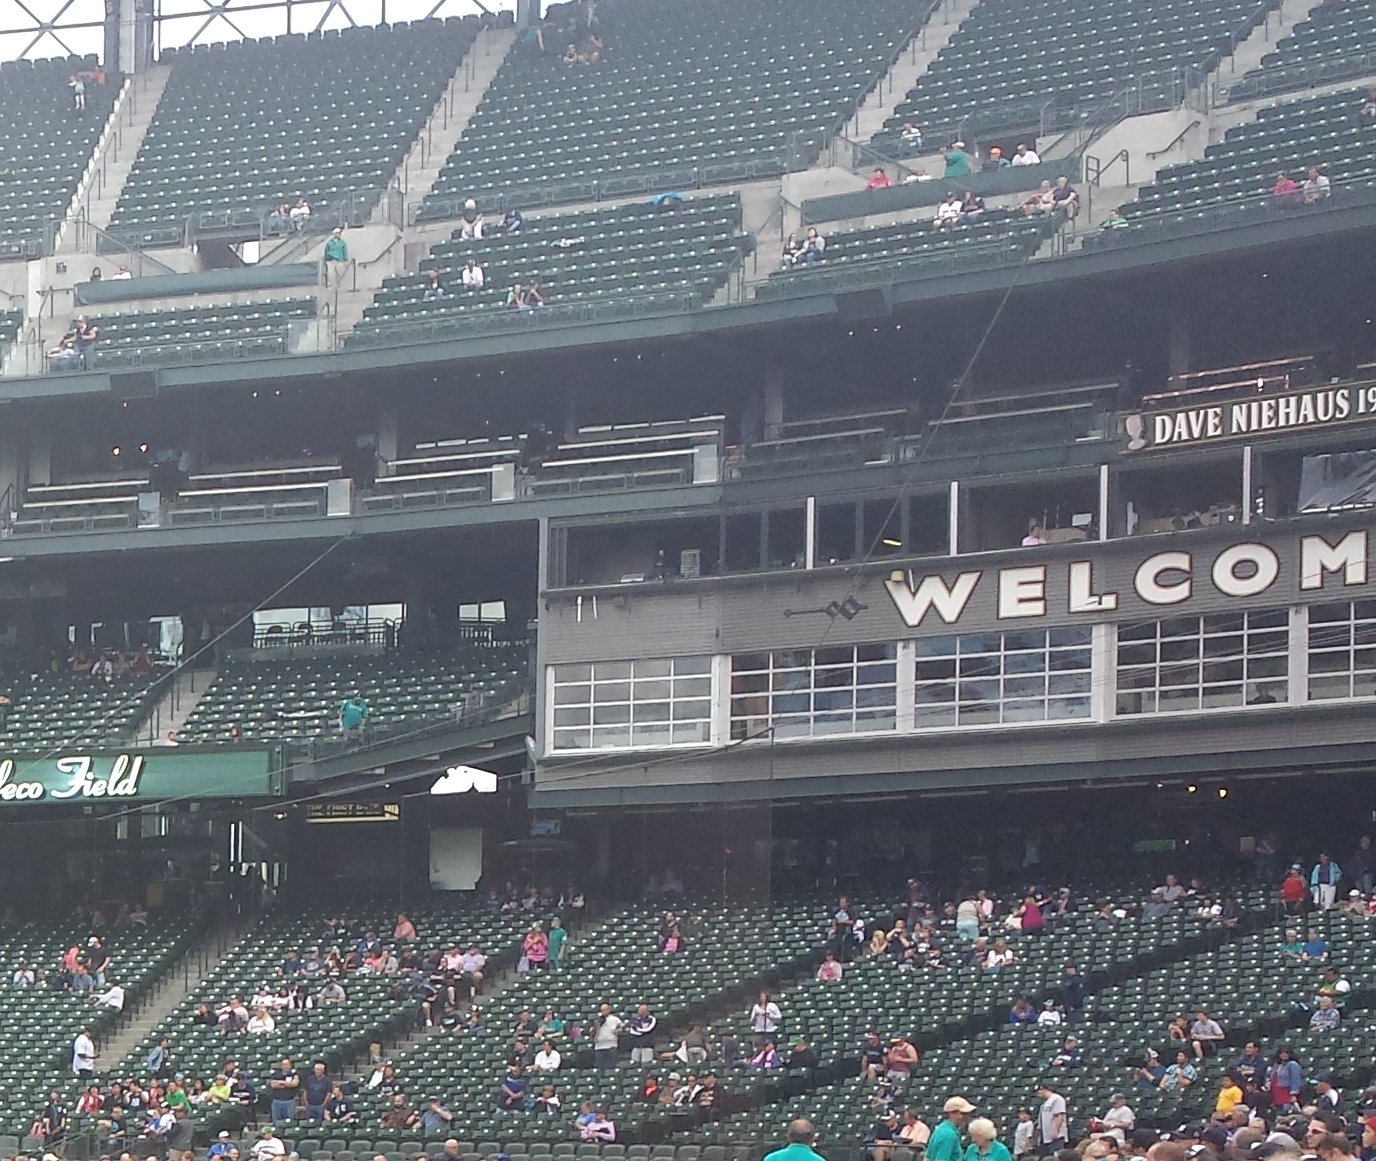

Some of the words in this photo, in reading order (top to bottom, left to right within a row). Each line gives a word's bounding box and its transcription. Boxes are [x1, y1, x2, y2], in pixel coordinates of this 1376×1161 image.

[1154, 406, 1223, 444] DAVE
[1231, 389, 1351, 434] NIEHAUS
[884, 531, 1369, 628] WELCOM
[50, 755, 145, 798] Field
